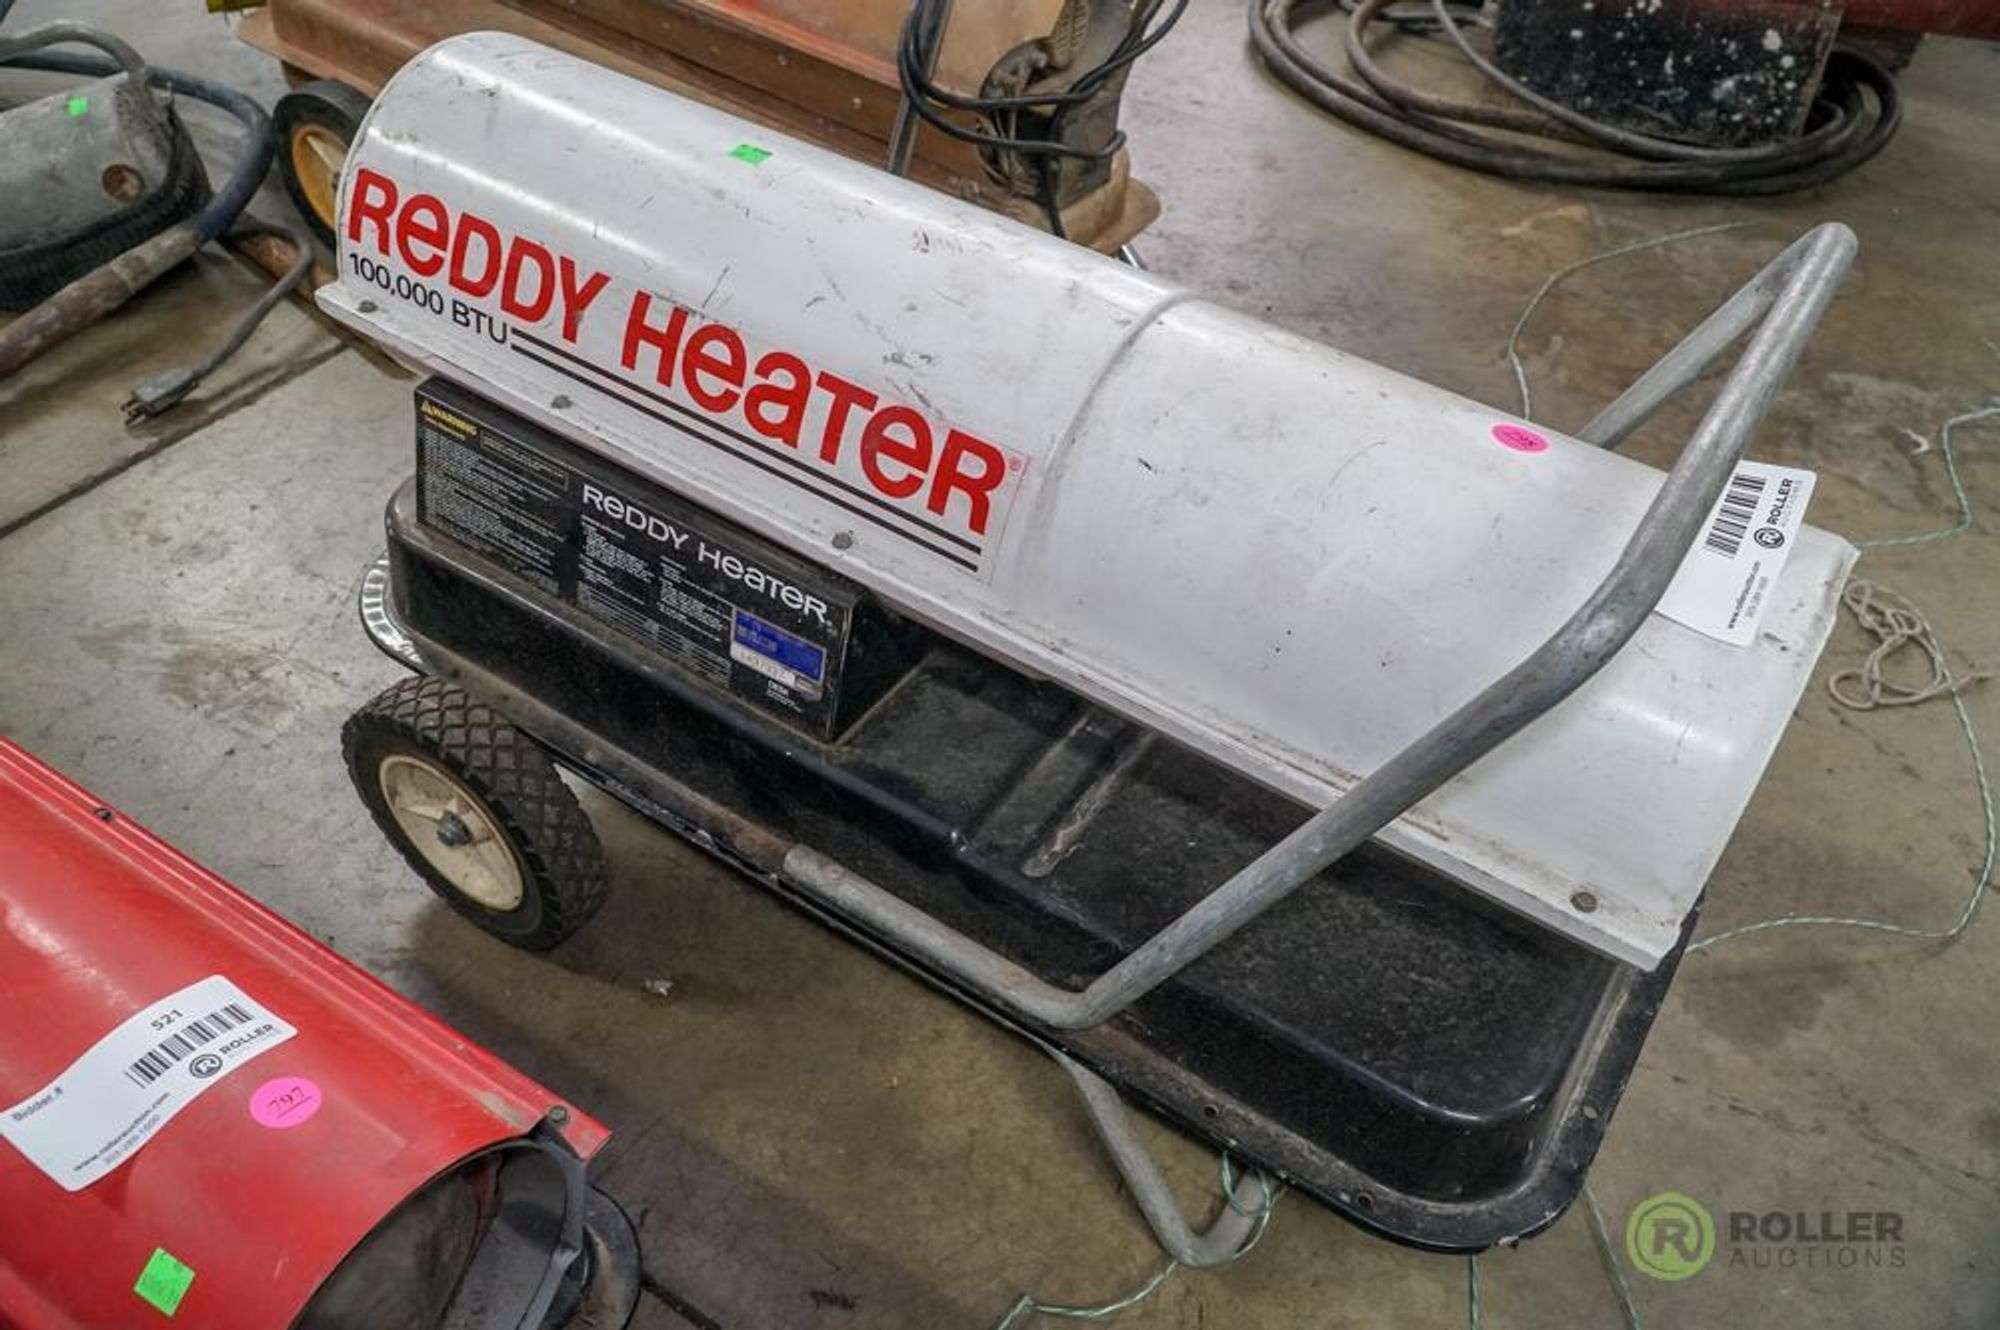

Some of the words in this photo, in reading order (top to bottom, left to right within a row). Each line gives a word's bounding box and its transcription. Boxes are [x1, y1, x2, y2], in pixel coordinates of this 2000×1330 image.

[349, 252, 444, 316] 100,000
[452, 298, 508, 345] BTU
[1766, 477, 1793, 526] ROLLER
[150, 1009, 183, 1031] 521
[219, 1023, 274, 1055] ROLLER
